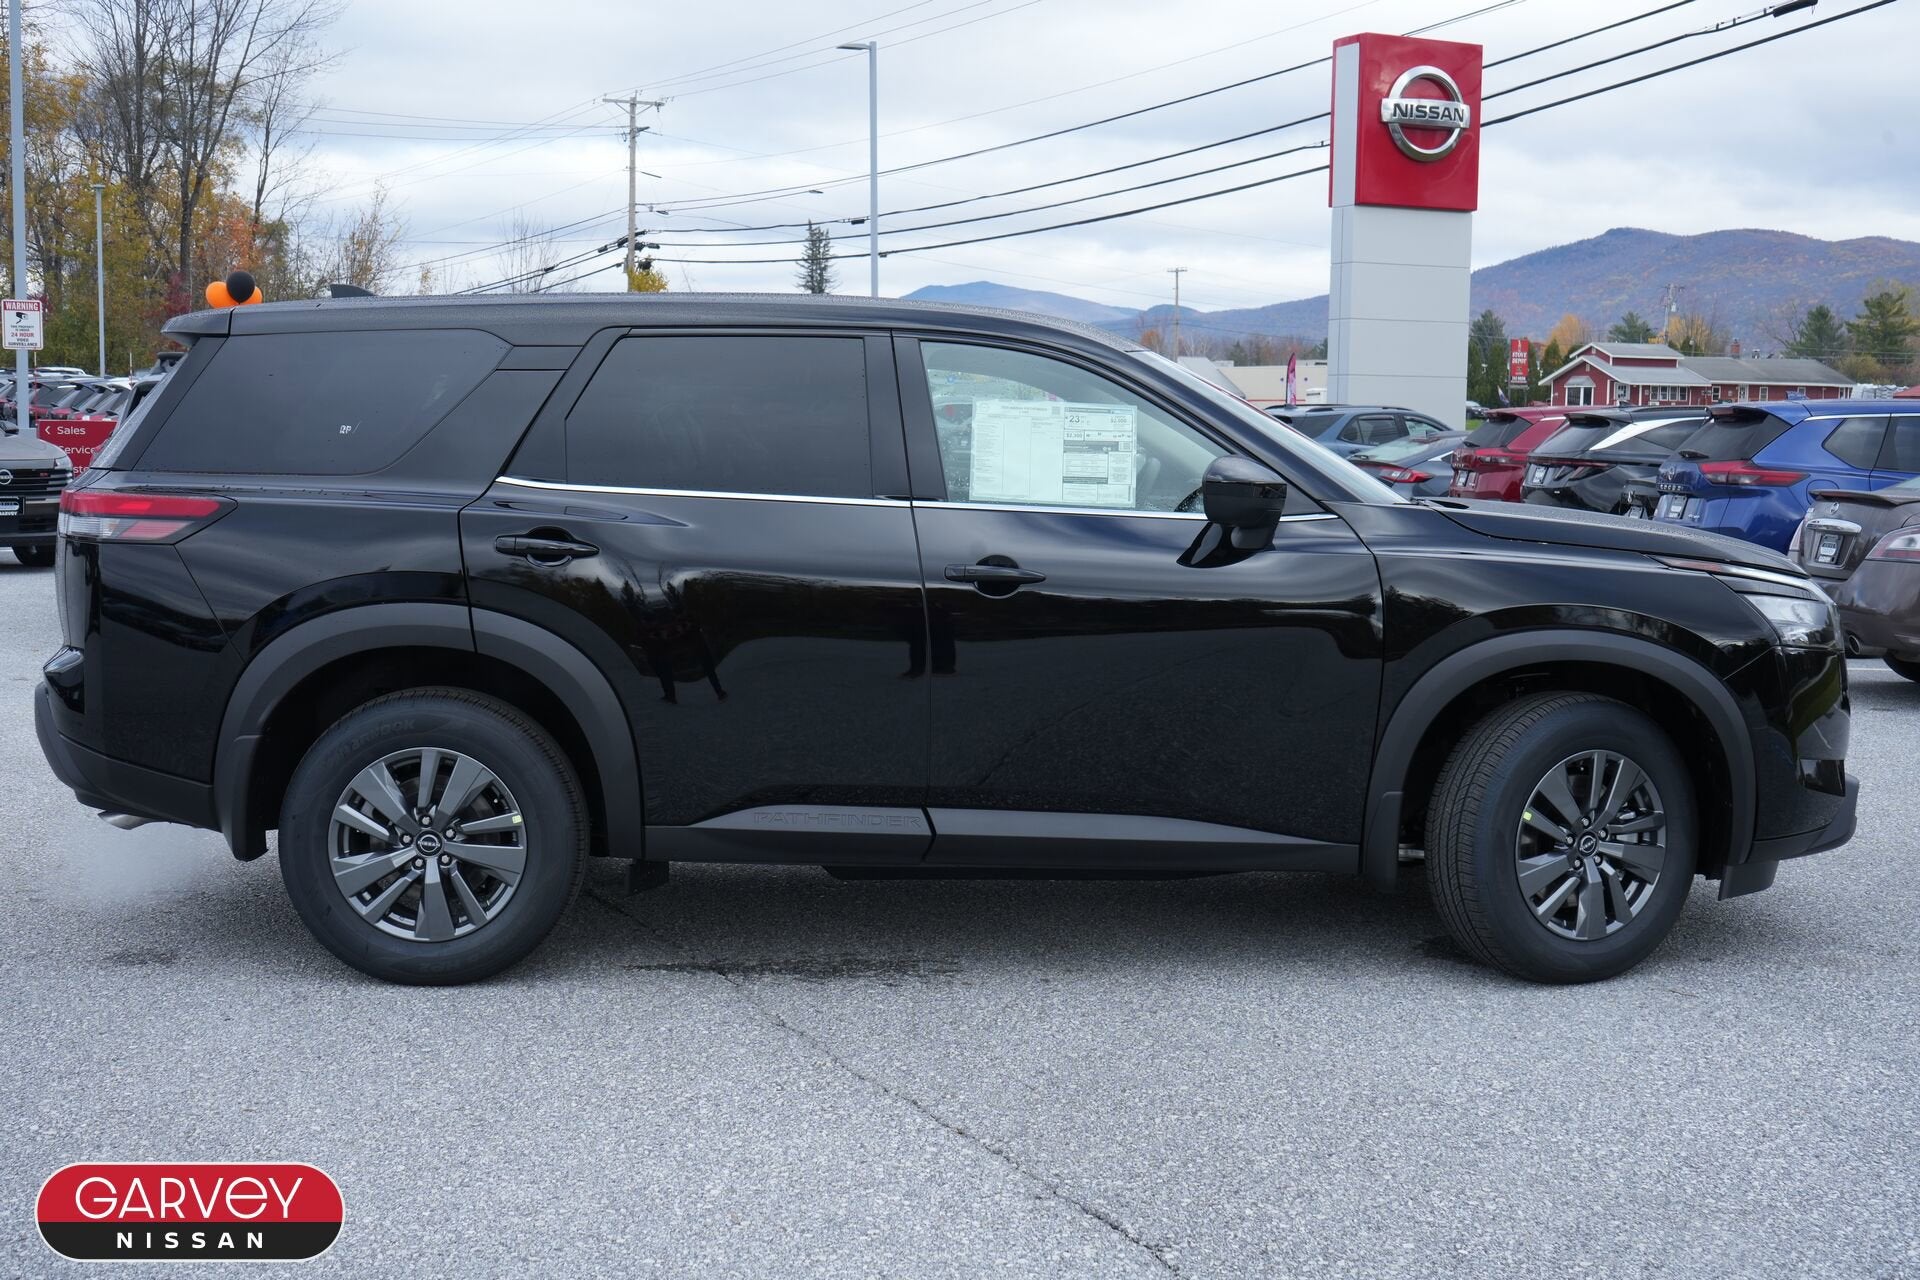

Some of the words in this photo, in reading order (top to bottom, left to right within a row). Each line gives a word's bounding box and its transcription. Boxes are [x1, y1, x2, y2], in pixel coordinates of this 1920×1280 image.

[1392, 103, 1465, 122] NISSAN
[6, 301, 39, 310] WARNING
[1069, 415, 1080, 423] 23
[57, 426, 86, 435] Sales
[753, 812, 922, 828] PATHFINDER
